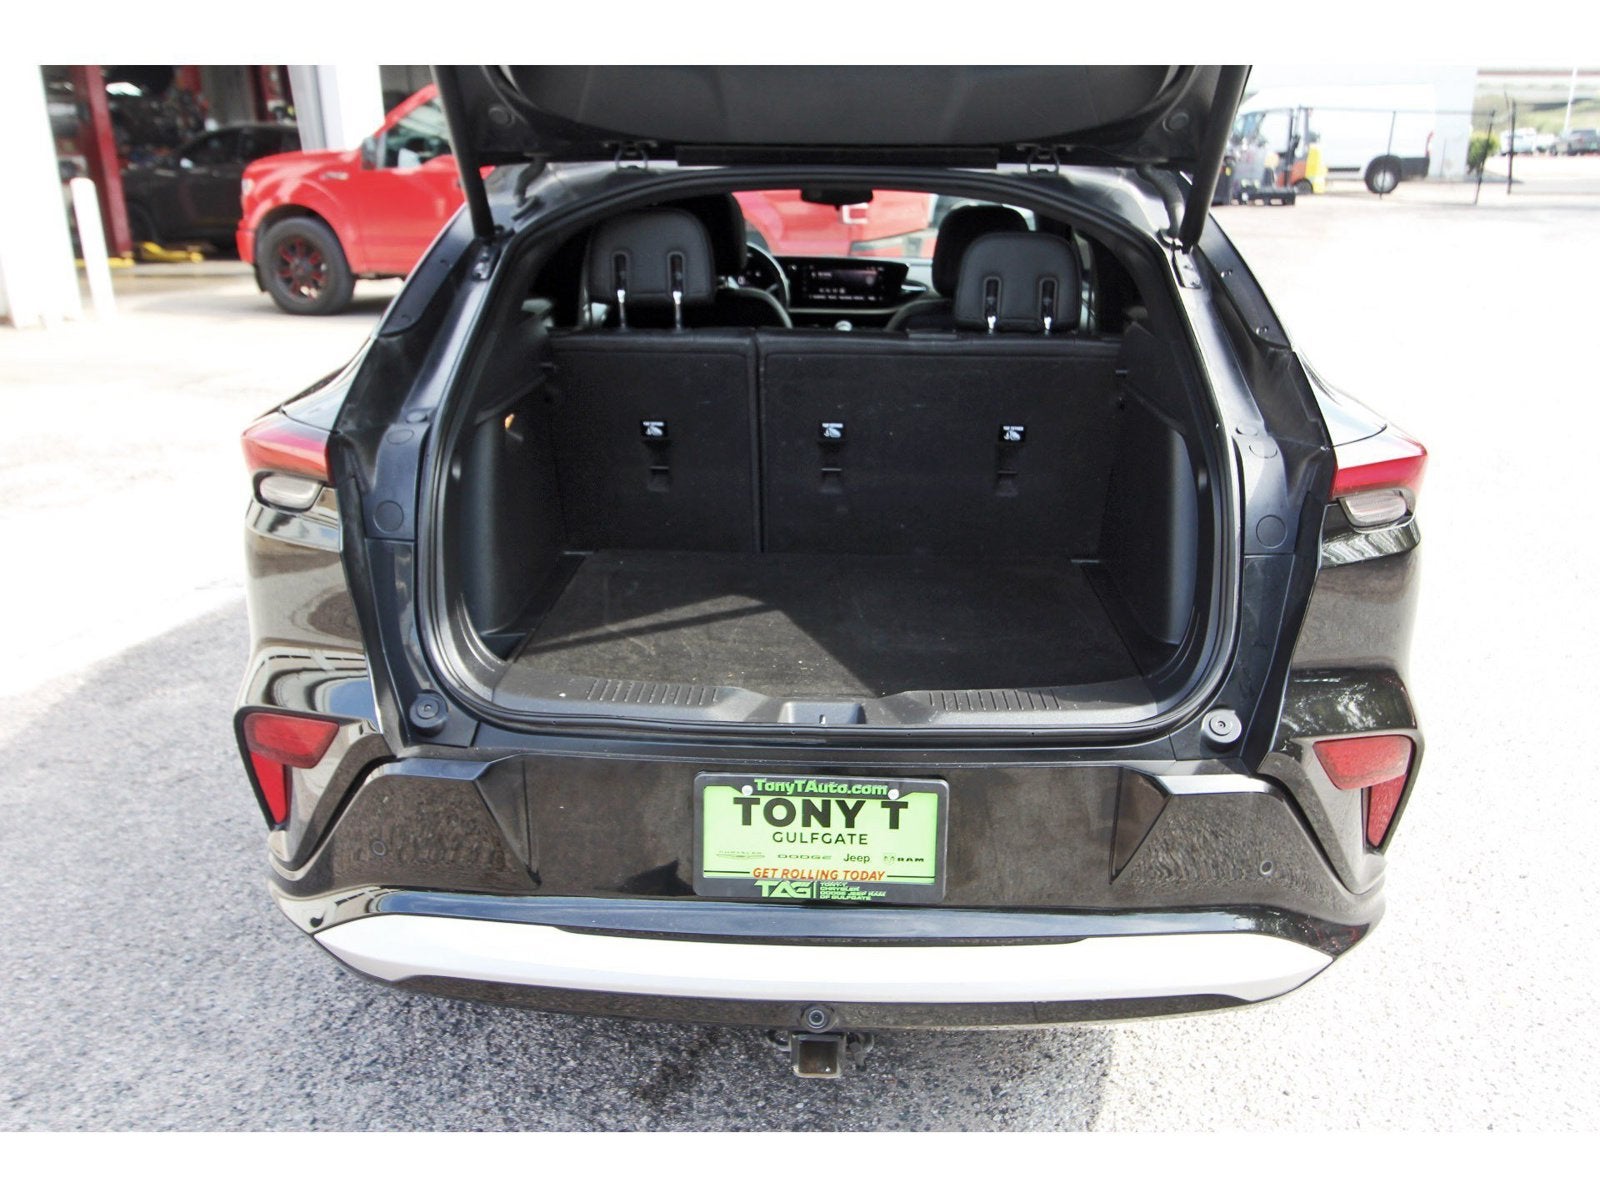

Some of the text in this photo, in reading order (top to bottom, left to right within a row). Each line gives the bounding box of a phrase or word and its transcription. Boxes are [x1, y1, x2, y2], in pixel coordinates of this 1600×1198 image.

[754, 778, 888, 796] TonyTAuto.com
[733, 797, 909, 830] TONY T
[772, 831, 868, 845] GULFGATE
[843, 852, 870, 864] Jeep
[753, 867, 886, 881] GET ROLLING TODAY
[754, 880, 811, 899] TAG
